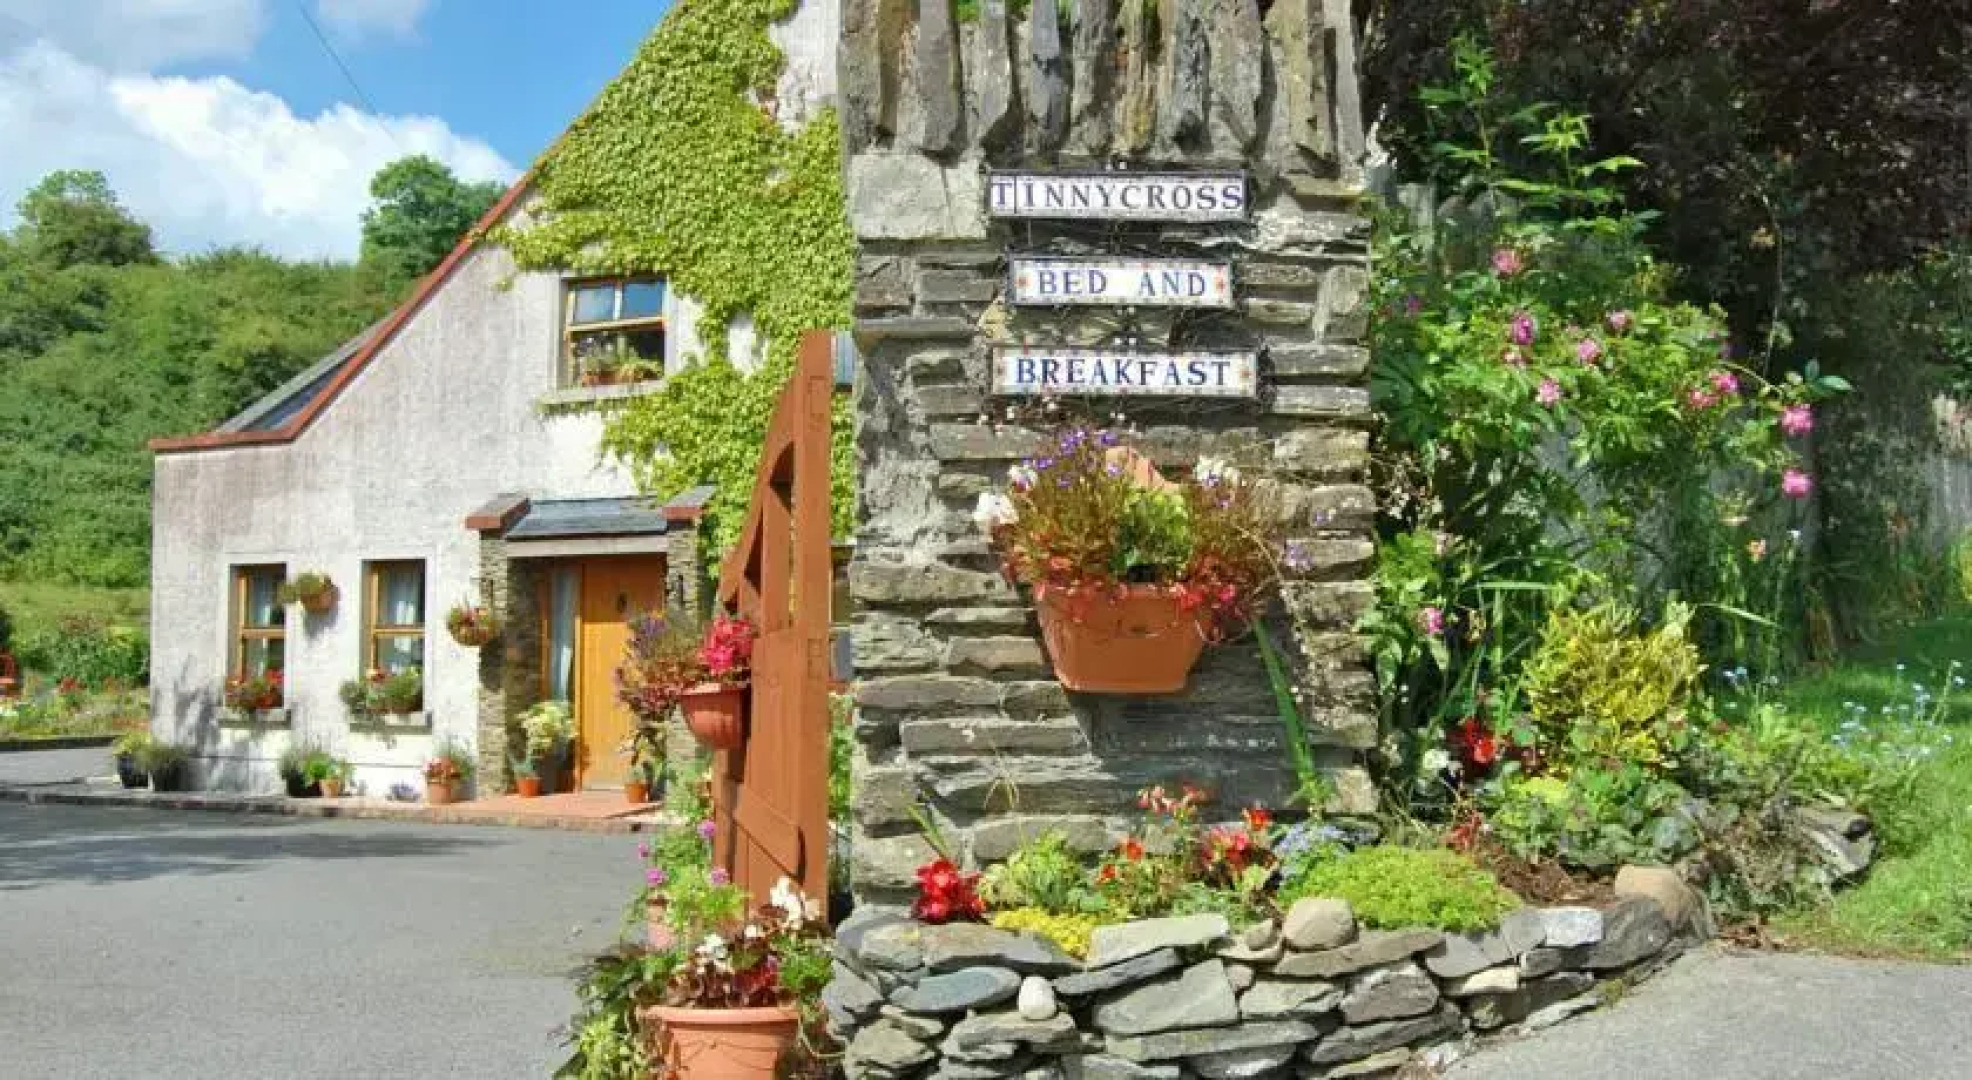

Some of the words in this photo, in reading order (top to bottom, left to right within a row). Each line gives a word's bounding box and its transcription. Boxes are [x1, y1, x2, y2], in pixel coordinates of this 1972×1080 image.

[992, 182, 1242, 209] TINNYCROSS
[1038, 269, 1108, 295] BED
[1138, 271, 1206, 297] AND
[1016, 357, 1231, 387] BREAKFAST
